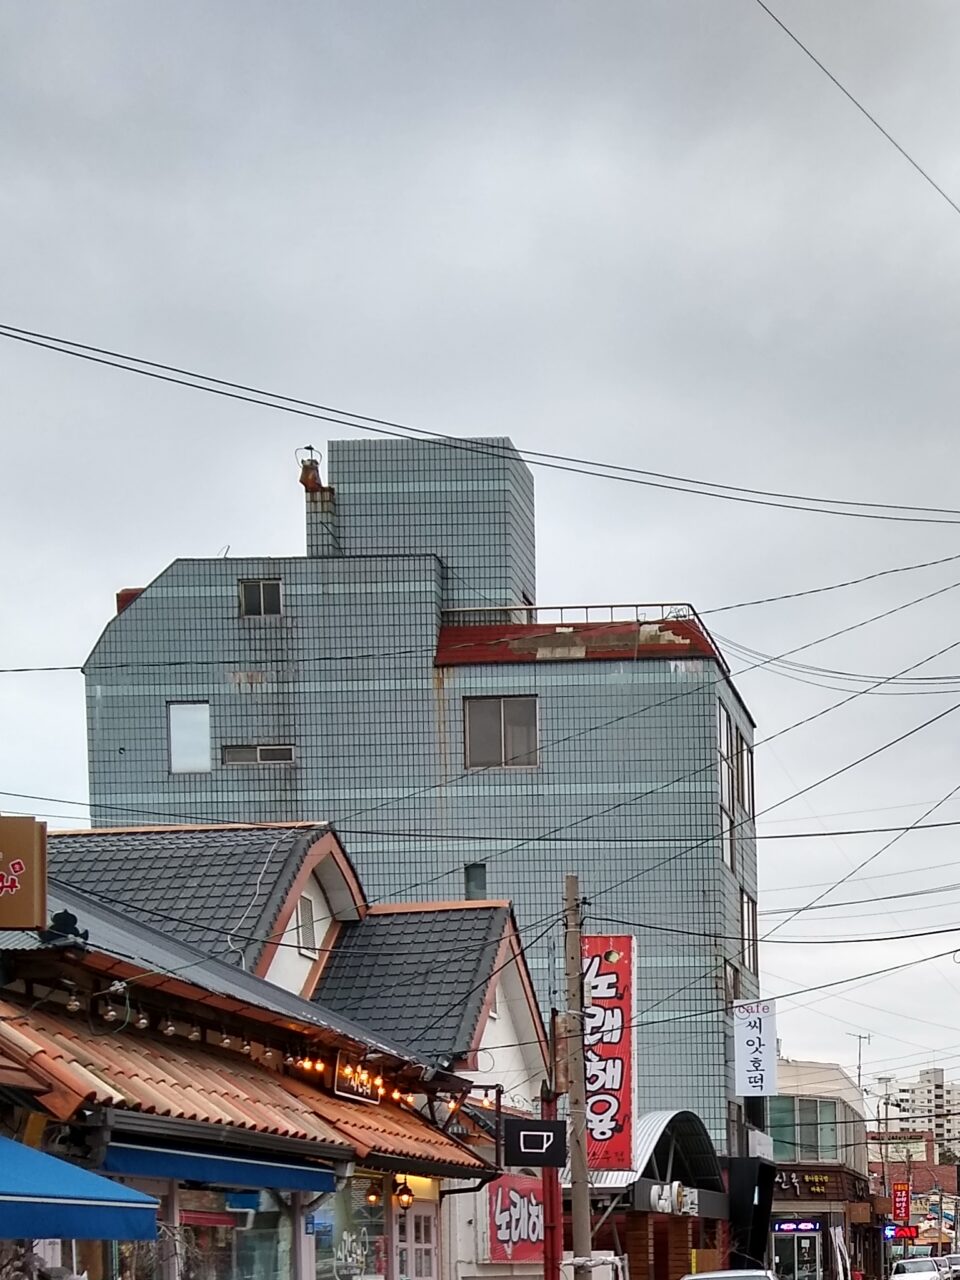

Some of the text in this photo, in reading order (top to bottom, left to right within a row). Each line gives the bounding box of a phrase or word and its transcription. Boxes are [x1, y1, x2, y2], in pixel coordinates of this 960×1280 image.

[738, 1003, 770, 1014] cafe
[582, 955, 623, 1141] 노래해용
[745, 1016, 767, 1092] 씨앗호떡
